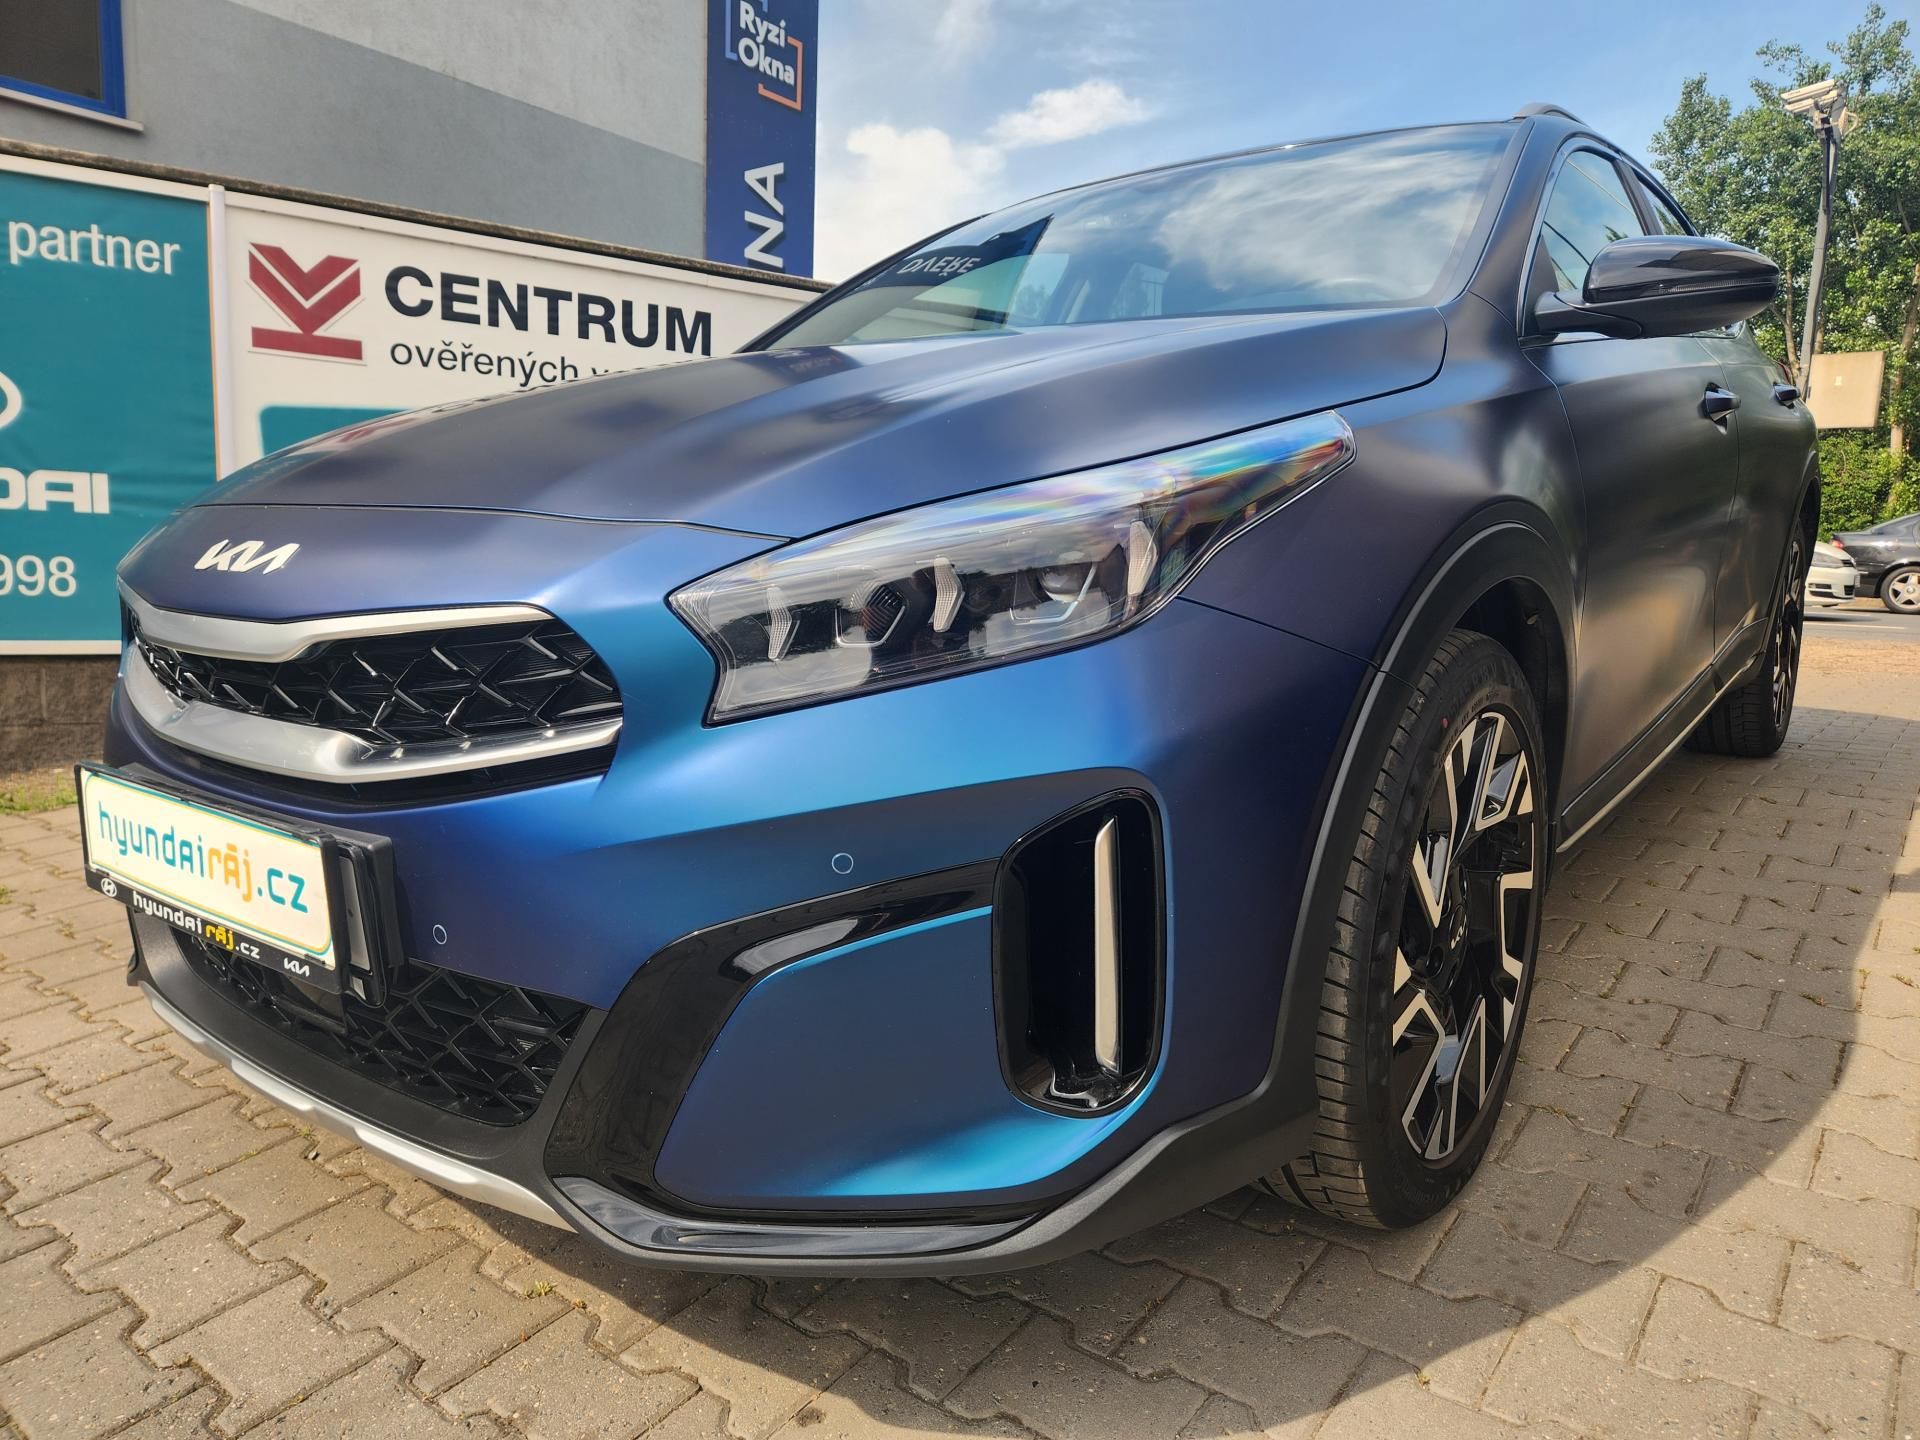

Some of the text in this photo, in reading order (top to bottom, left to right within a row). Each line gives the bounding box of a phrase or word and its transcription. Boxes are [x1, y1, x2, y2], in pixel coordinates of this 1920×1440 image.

[740, 0, 786, 48] Ryzi
[738, 37, 795, 86] Okna
[8, 220, 181, 275] partner
[384, 265, 712, 357] CENTRUM
[390, 340, 578, 387] ověřených
